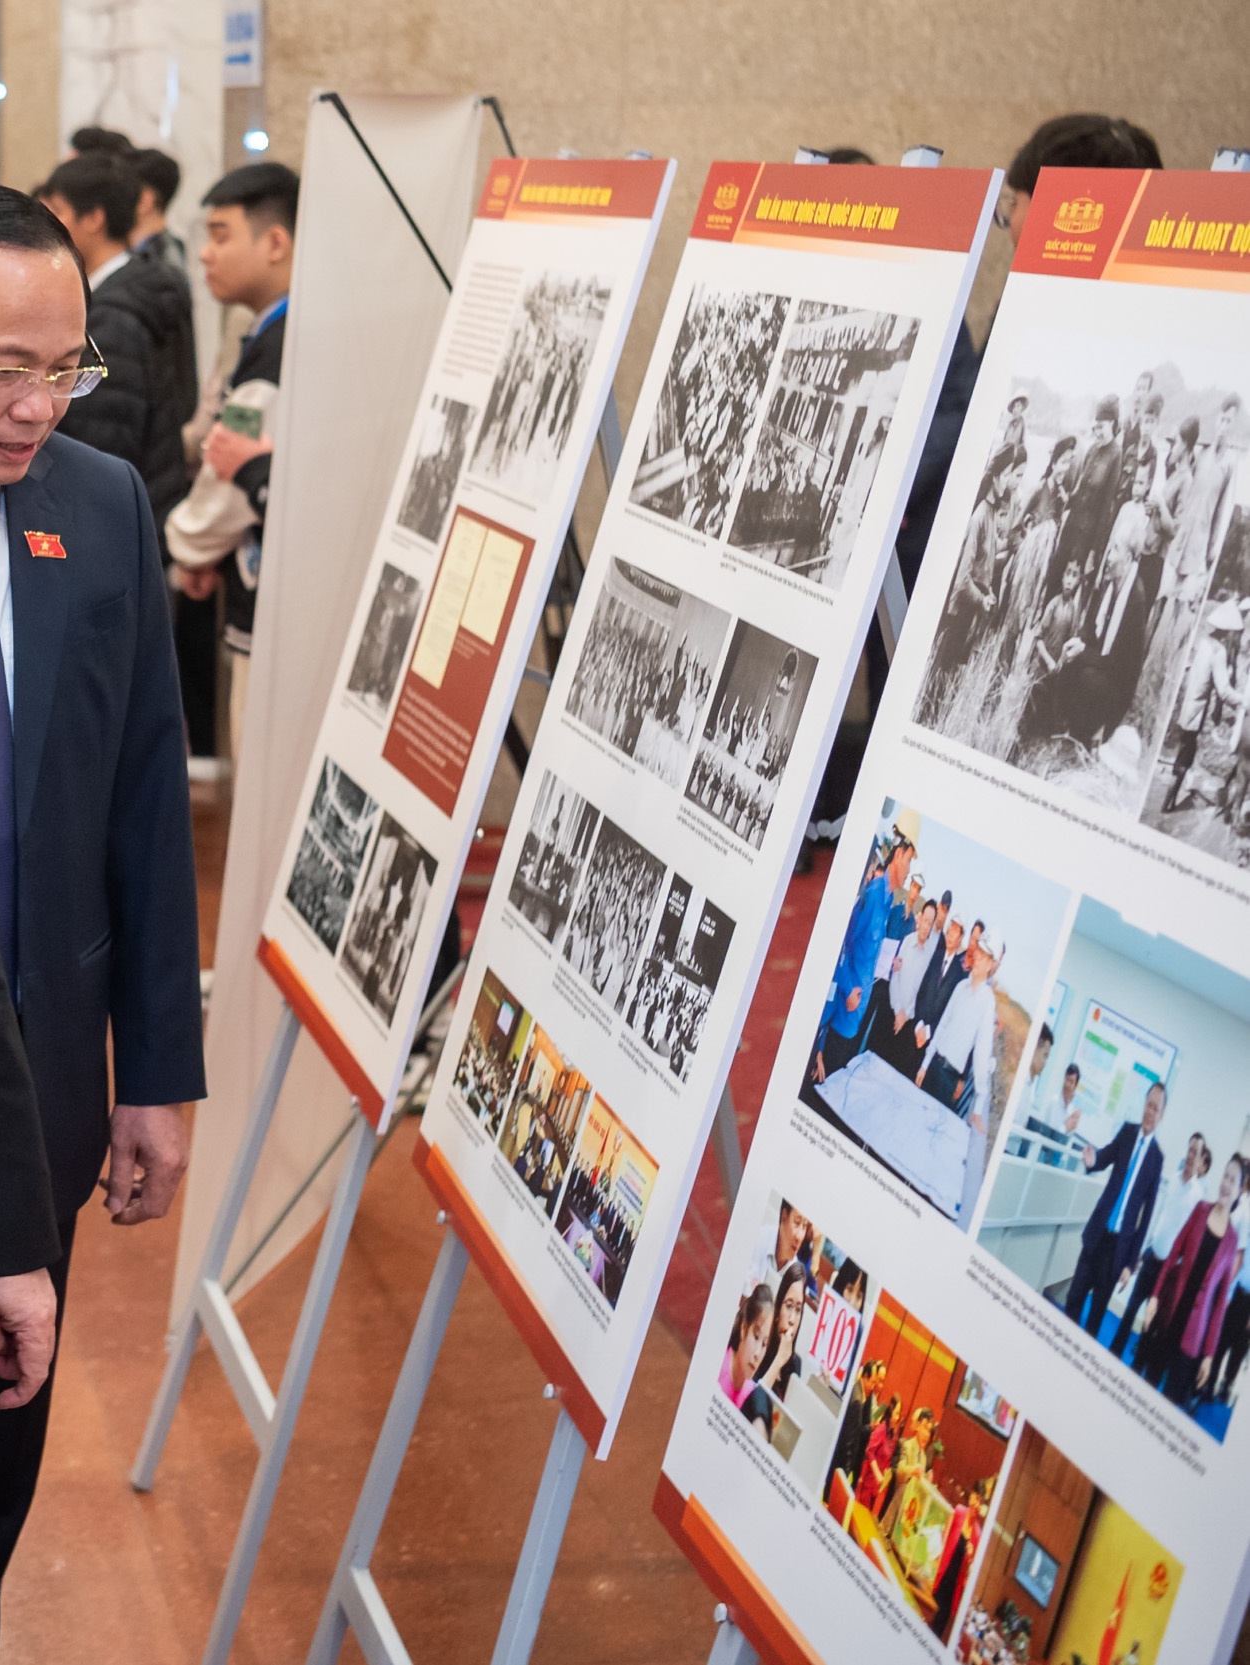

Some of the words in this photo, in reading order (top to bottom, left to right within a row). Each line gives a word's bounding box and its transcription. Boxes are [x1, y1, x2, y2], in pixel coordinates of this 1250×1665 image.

[1145, 210, 1176, 248] DẤU
[1172, 211, 1195, 249] ẤN
[1192, 221, 1233, 256] HOẠT
